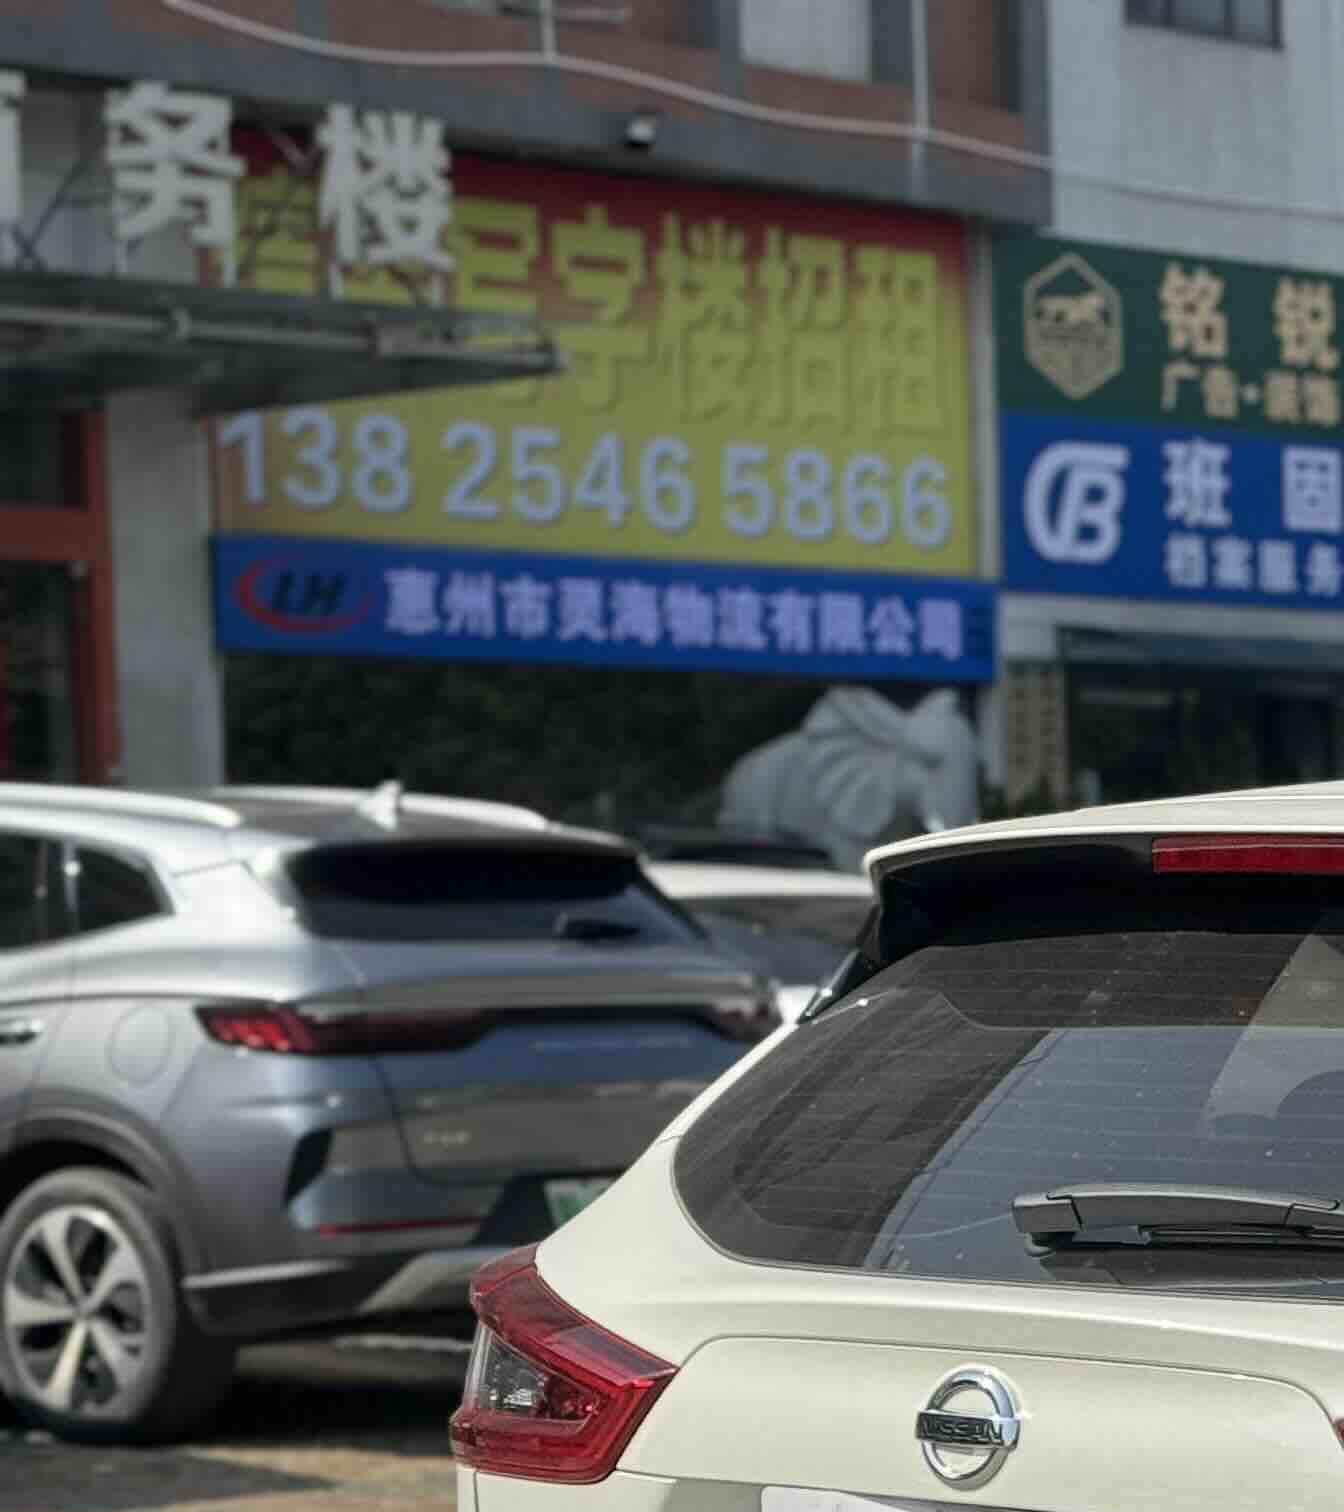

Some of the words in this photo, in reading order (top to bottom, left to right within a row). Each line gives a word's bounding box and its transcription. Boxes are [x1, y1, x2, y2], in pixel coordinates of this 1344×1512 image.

[0, 71, 455, 272] 务楼
[218, 405, 411, 515] 138
[440, 419, 699, 537] 2546
[721, 443, 955, 550] 5866
[1161, 436, 1344, 534] 班固
